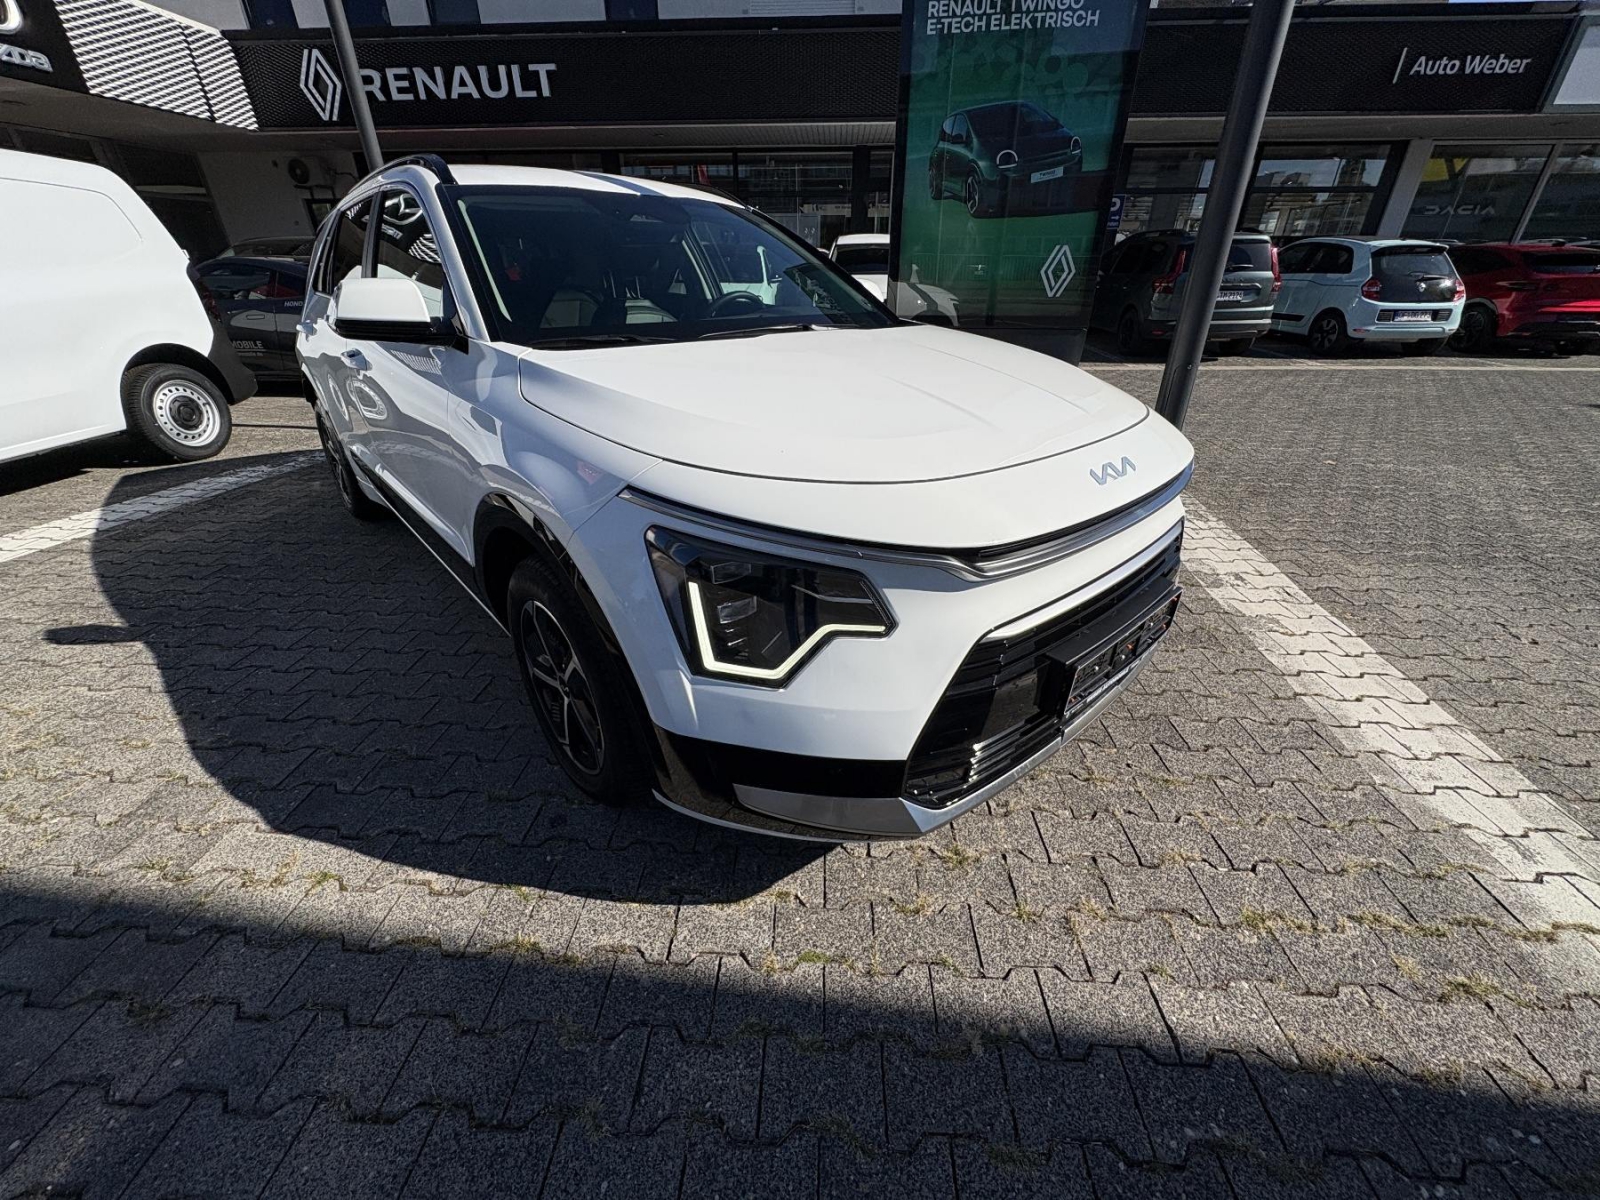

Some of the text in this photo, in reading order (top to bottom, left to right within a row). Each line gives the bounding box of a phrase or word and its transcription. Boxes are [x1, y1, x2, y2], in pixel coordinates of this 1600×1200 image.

[927, 0, 1085, 17] RENAULT TWINGO
[927, 9, 1100, 35] E-TECH ELEKTRISCH
[1409, 53, 1533, 76] Auto Weber
[358, 63, 557, 102] RENAULT
[1424, 204, 1496, 215] DACIA
[1089, 456, 1136, 485] KIA
